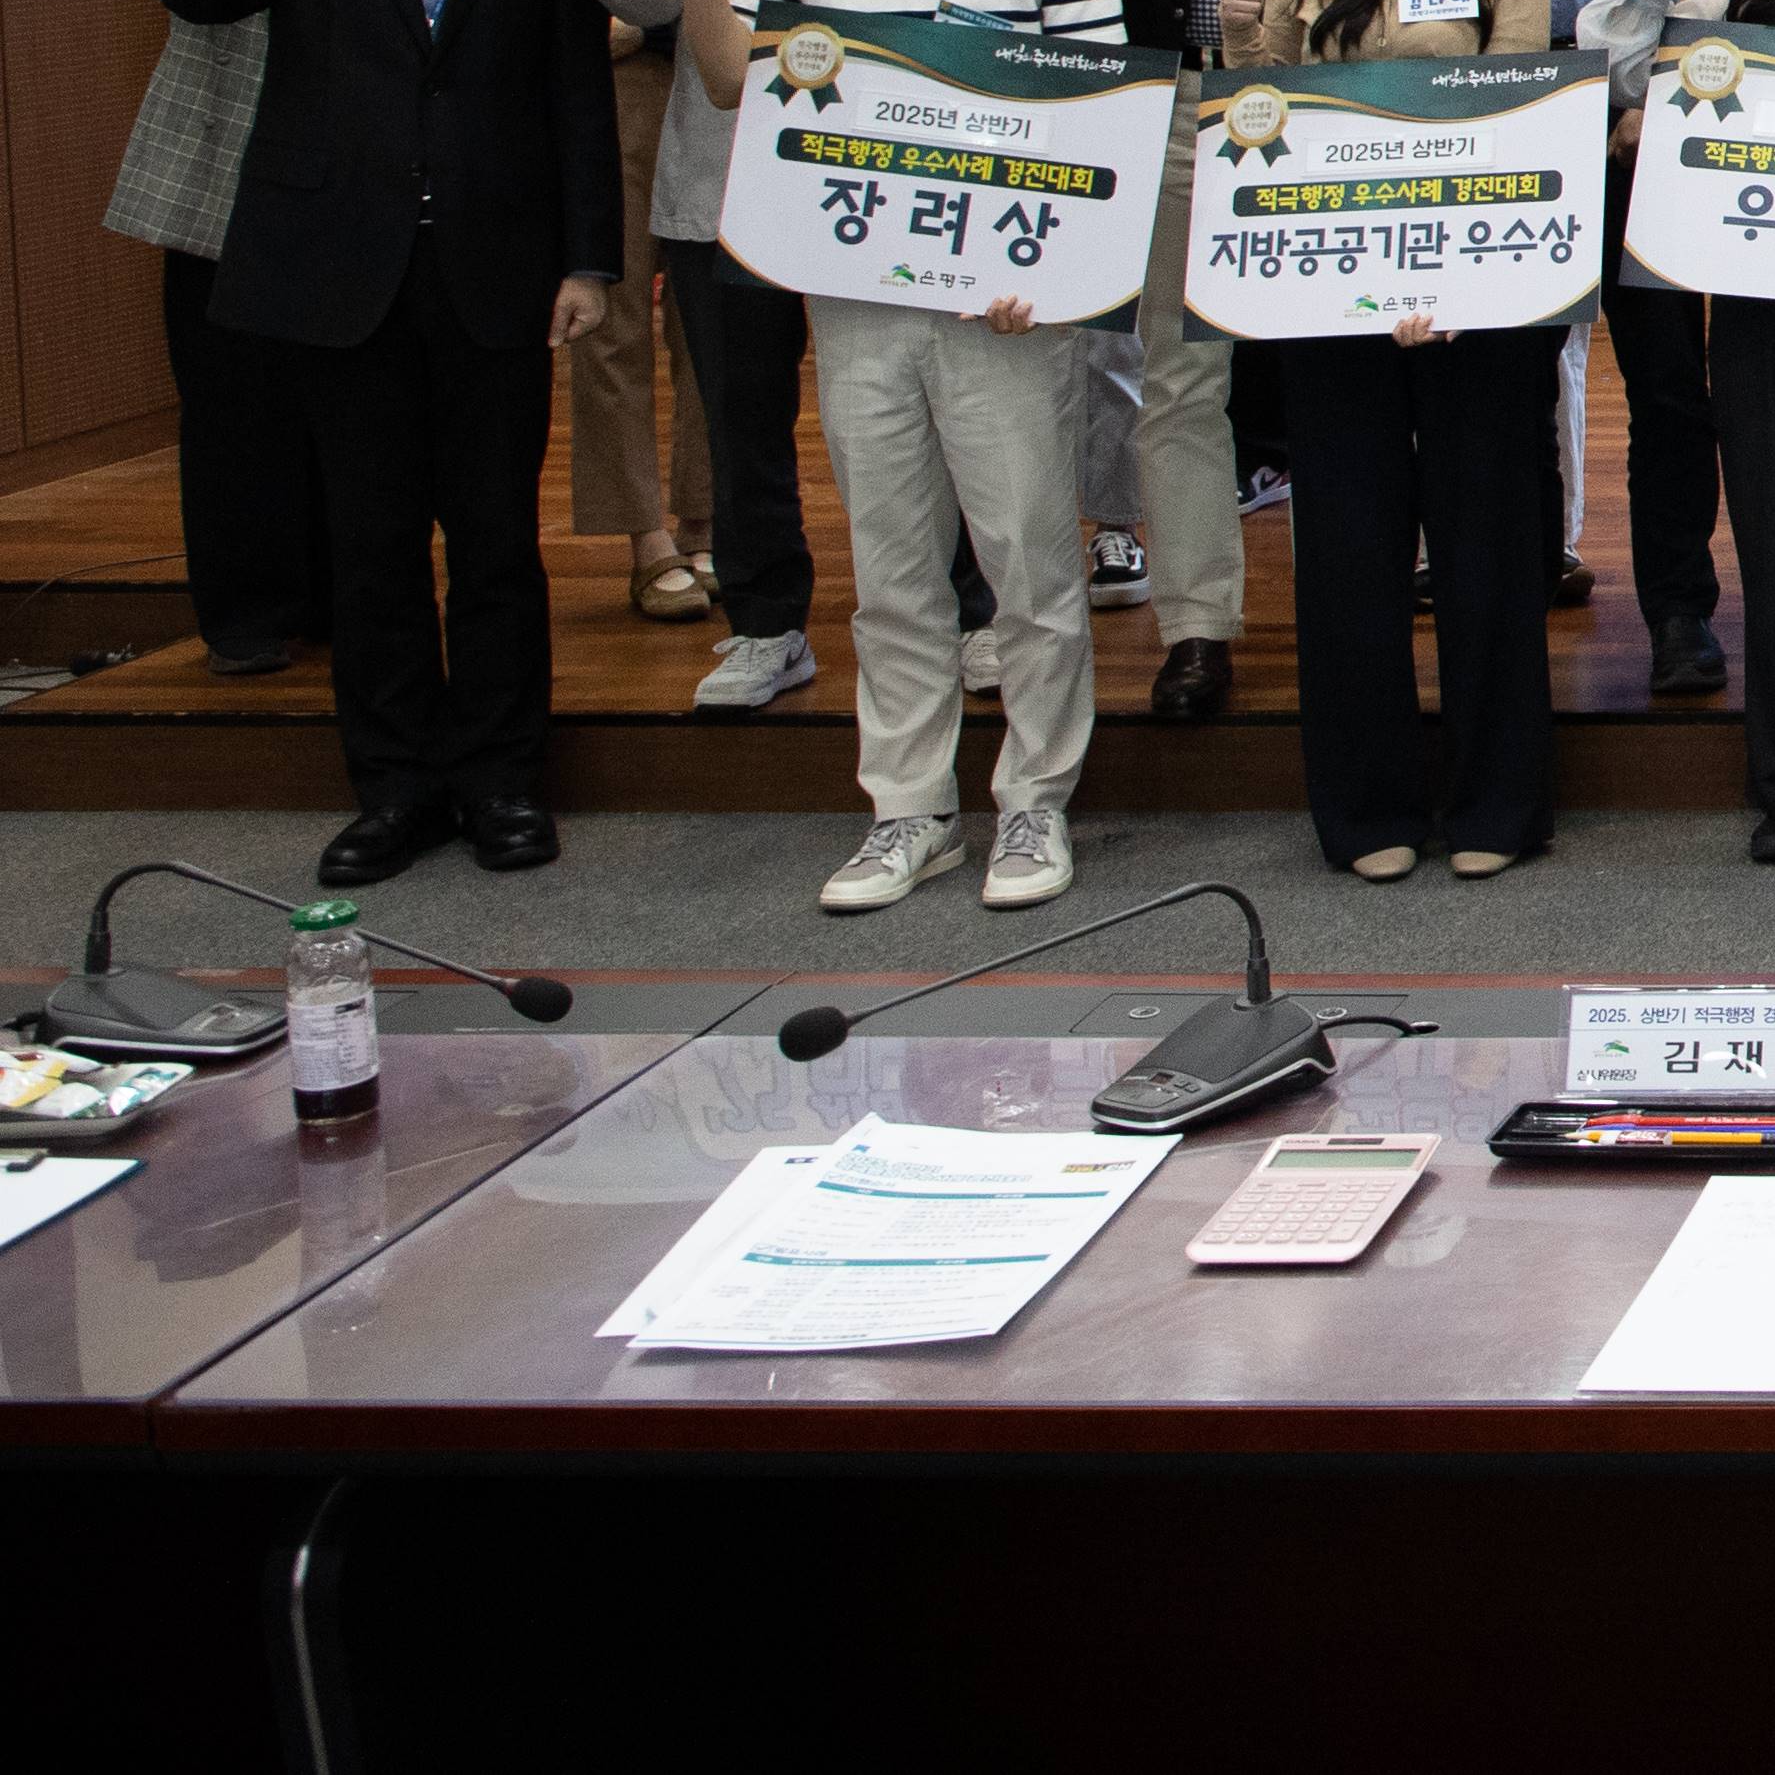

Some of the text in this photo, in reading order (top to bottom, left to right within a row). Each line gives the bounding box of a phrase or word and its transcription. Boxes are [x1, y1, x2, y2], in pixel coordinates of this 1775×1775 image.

[875, 100, 1032, 139] 2025년 상반기
[801, 132, 1095, 194] 적극행정 우수사례 경진대회
[1325, 135, 1476, 164] 2025년 상반기
[1255, 173, 1542, 212] 적극행정 우수사례 경진대회
[1208, 213, 1582, 278] 지방공공기관 우수상
[1588, 1007, 1632, 1024] 2025.
[1640, 1006, 1687, 1024] 상반기
[1694, 1006, 1756, 1024] 적극행정
